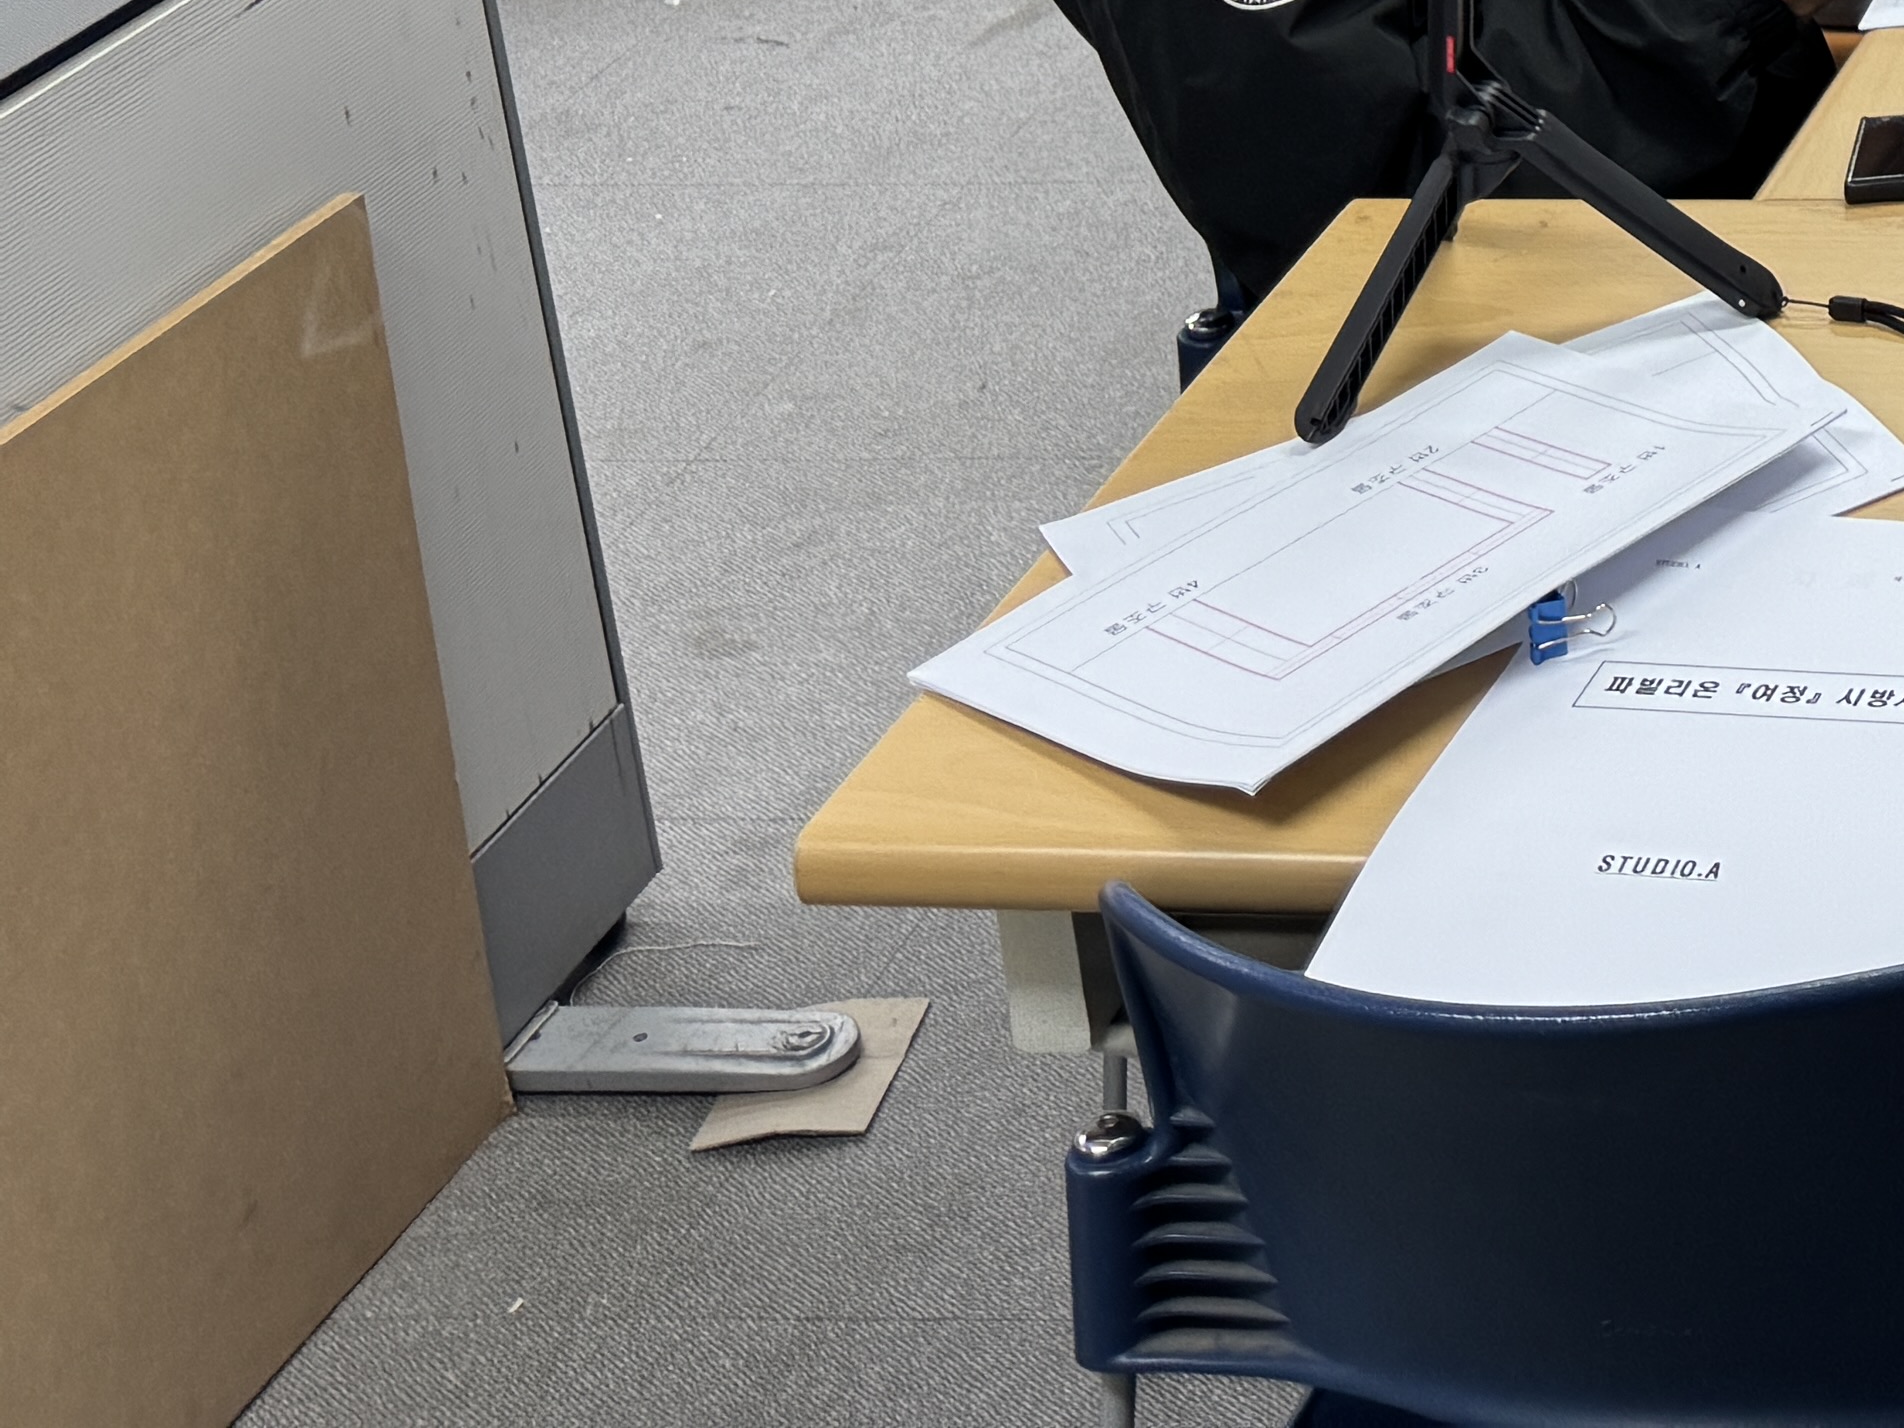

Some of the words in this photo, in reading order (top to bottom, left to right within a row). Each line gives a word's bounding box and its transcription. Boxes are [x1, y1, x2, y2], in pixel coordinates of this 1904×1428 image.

[1604, 673, 1720, 702] 파빌리온
[1735, 681, 1825, 708] 『여정』
[1597, 853, 1721, 880] STUDIO.A
